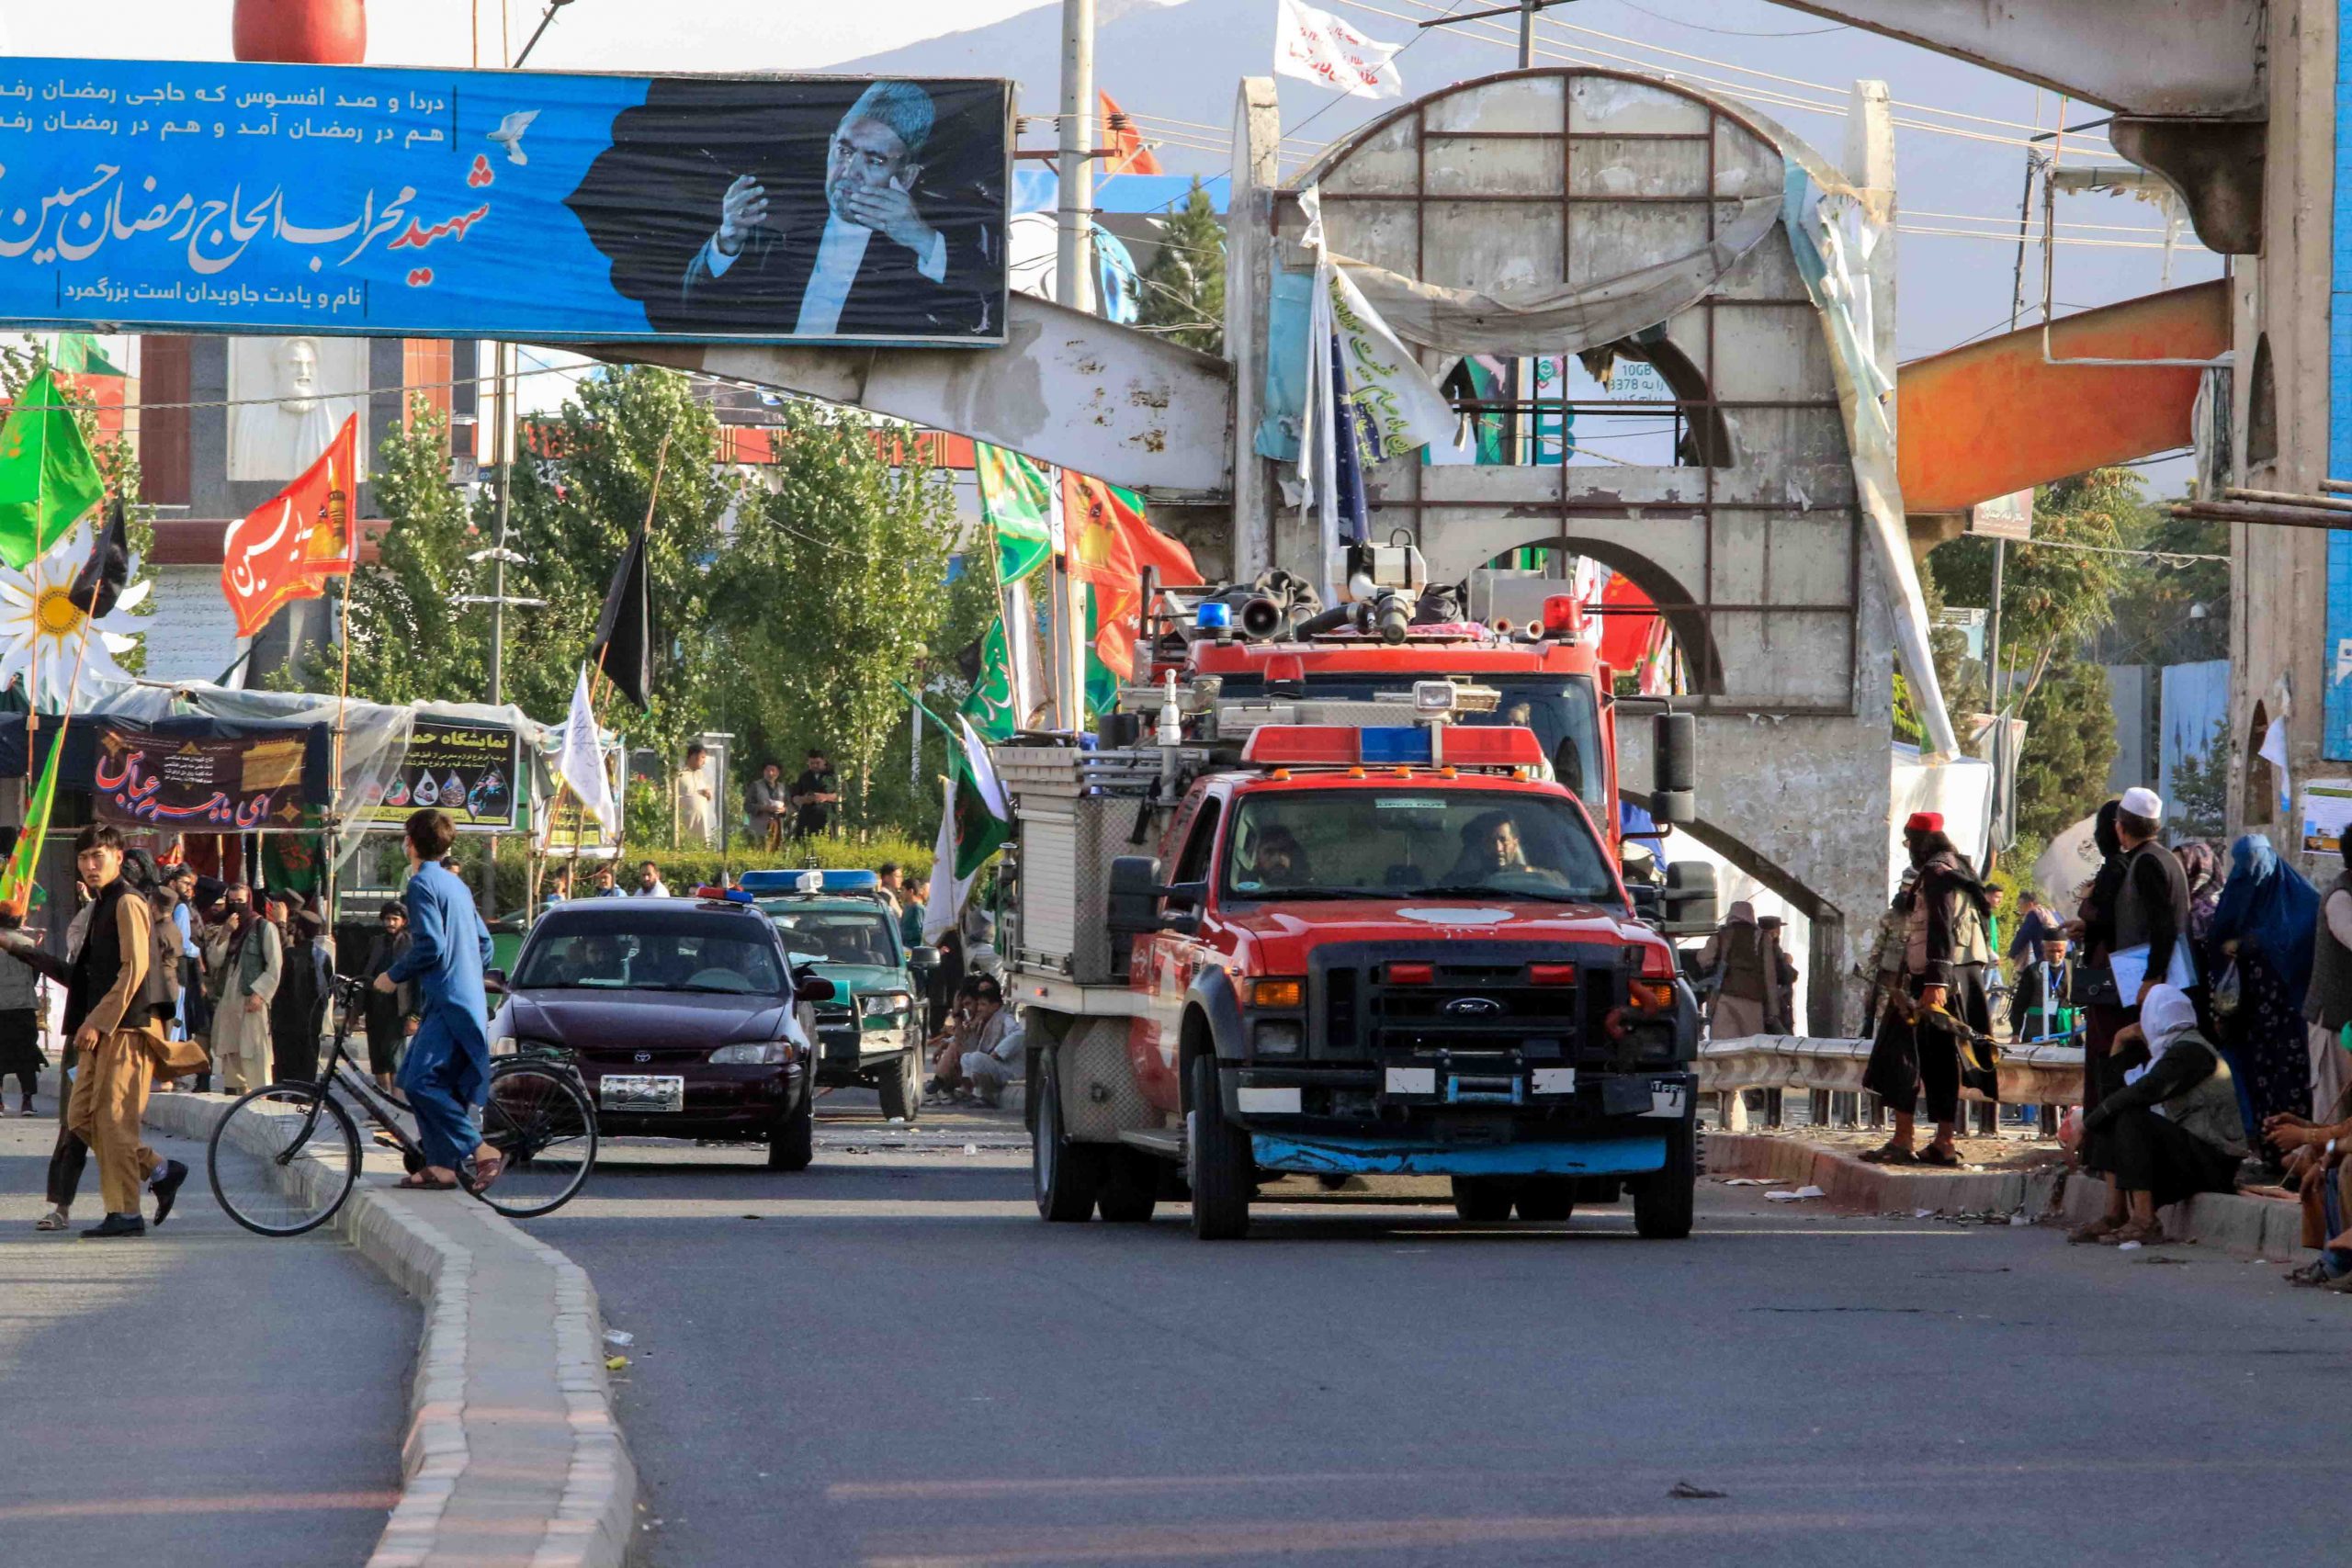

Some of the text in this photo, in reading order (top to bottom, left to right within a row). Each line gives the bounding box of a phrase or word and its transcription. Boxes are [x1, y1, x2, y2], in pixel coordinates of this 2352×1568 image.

[0, 78, 445, 114] دردا و صد افسوس که حاجی رمضان رف
[0, 109, 445, 150] هم در رمضان آمد و هم در رمضان رف
[0, 153, 494, 288] شهید محراب الحاج رمضان حسین
[63, 276, 361, 314] نام و یادت جاویدان است بزرگمرد
[1622, 364, 1652, 377] 10GB
[440, 730, 508, 751] نمایشگاه
